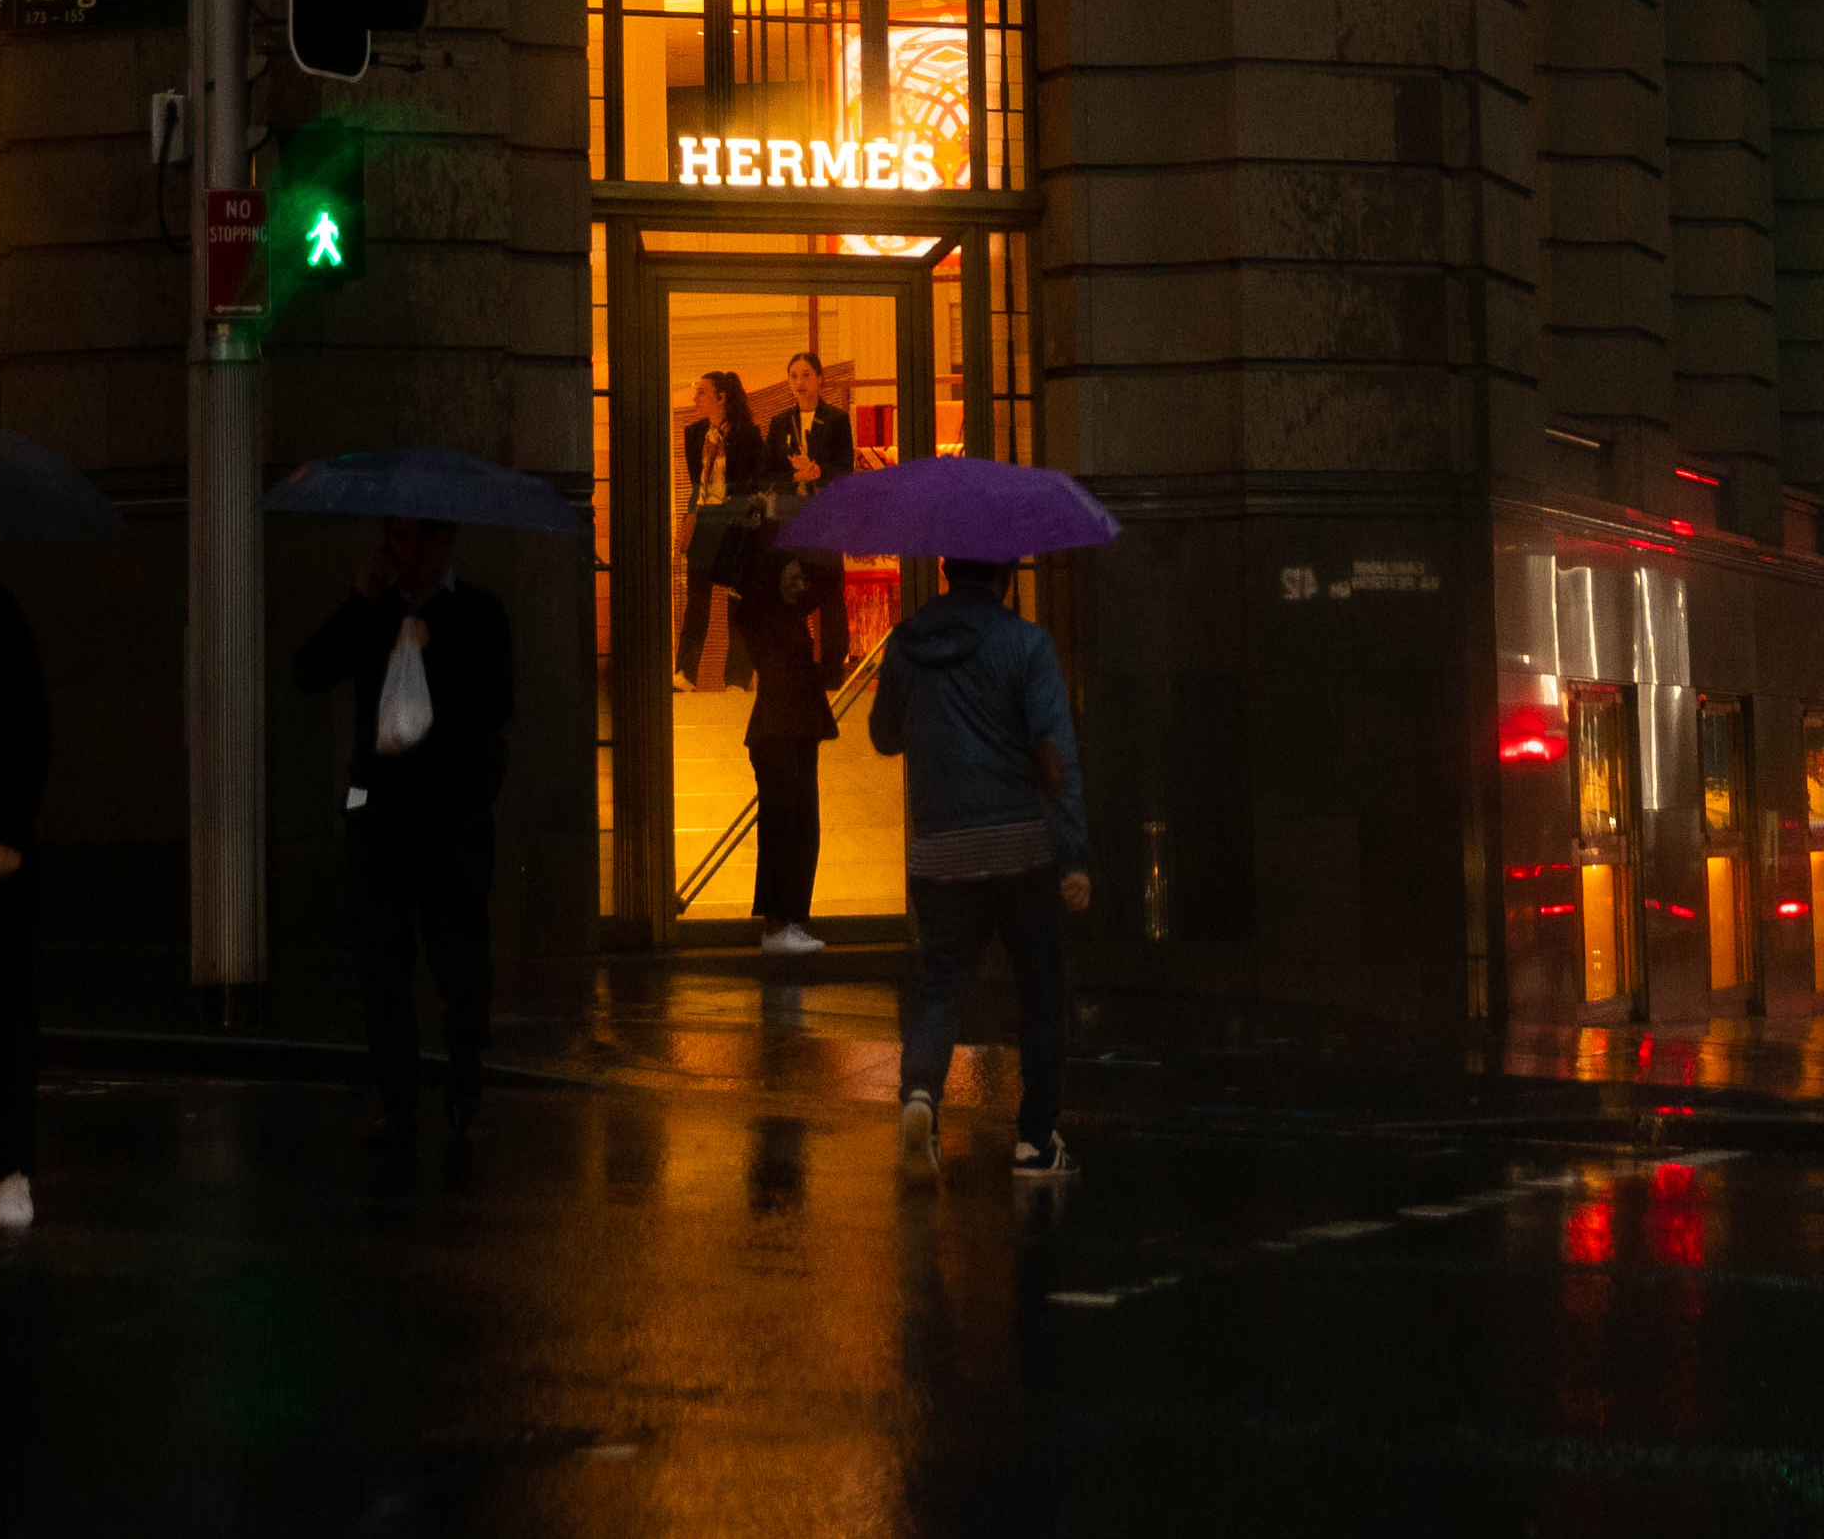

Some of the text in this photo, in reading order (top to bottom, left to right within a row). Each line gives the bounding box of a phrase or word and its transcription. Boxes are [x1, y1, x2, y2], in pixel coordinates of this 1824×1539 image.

[26, 10, 47, 25] 173
[225, 200, 252, 220] NO
[209, 225, 268, 243] STOPPING
